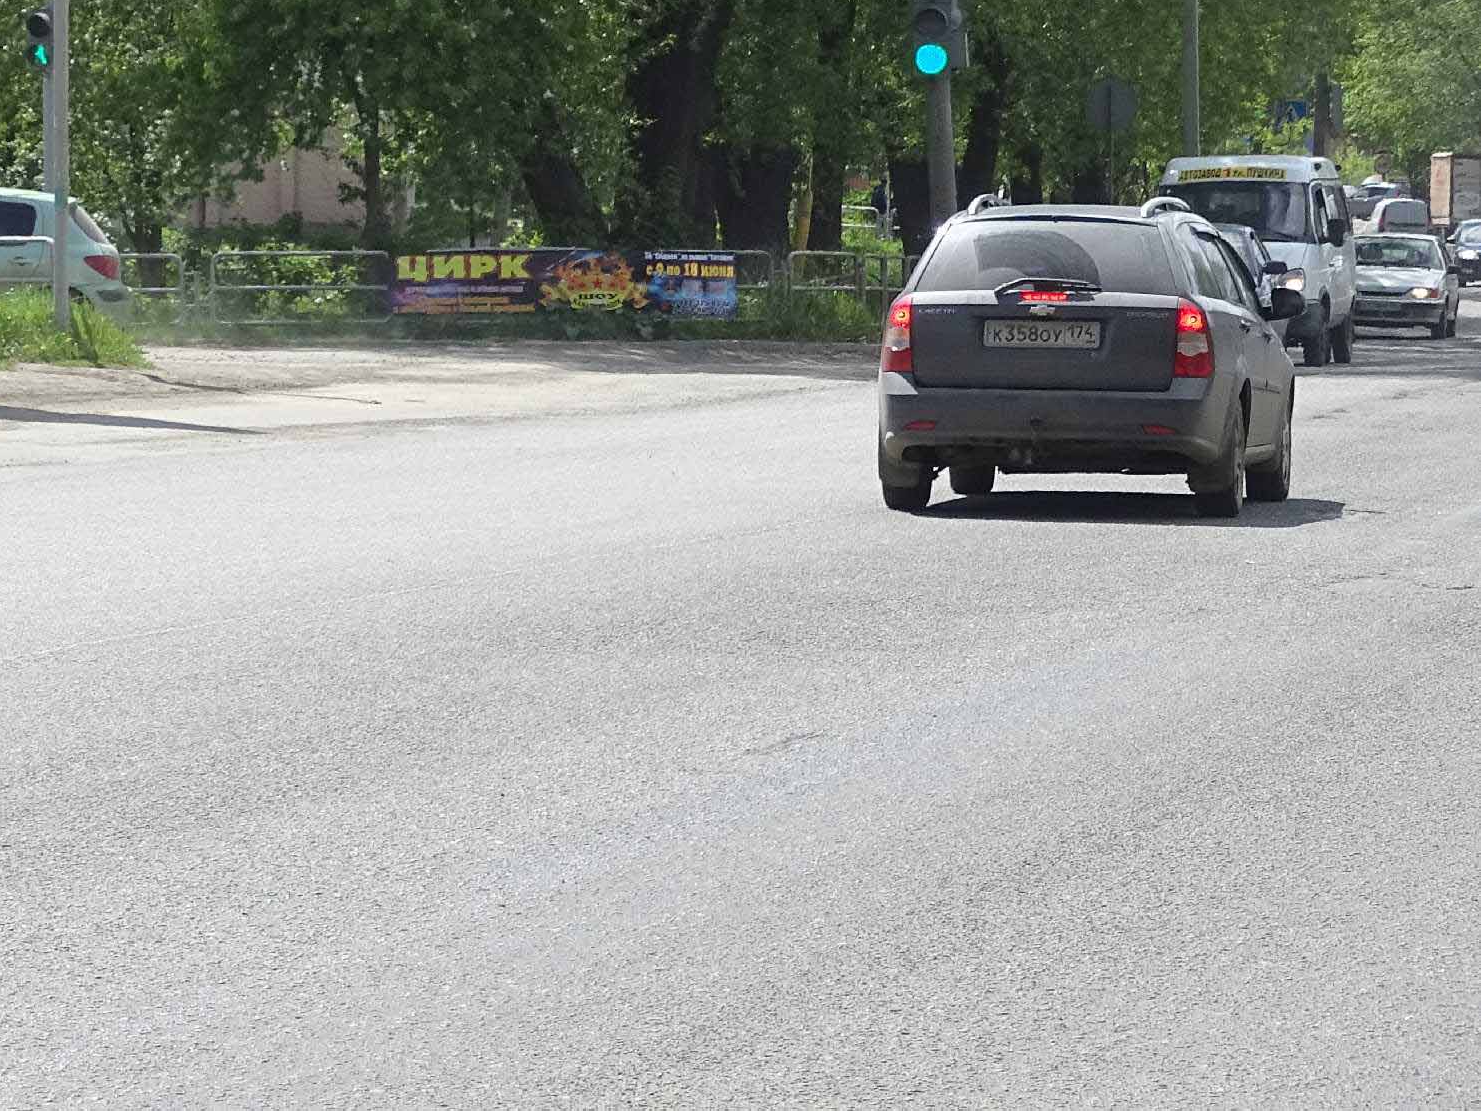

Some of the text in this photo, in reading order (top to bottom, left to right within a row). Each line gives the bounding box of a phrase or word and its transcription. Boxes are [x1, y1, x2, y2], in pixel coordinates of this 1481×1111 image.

[397, 253, 533, 282] ЦИРК
[666, 265, 681, 276] по
[992, 324, 1094, 343] К358ОУ 174
